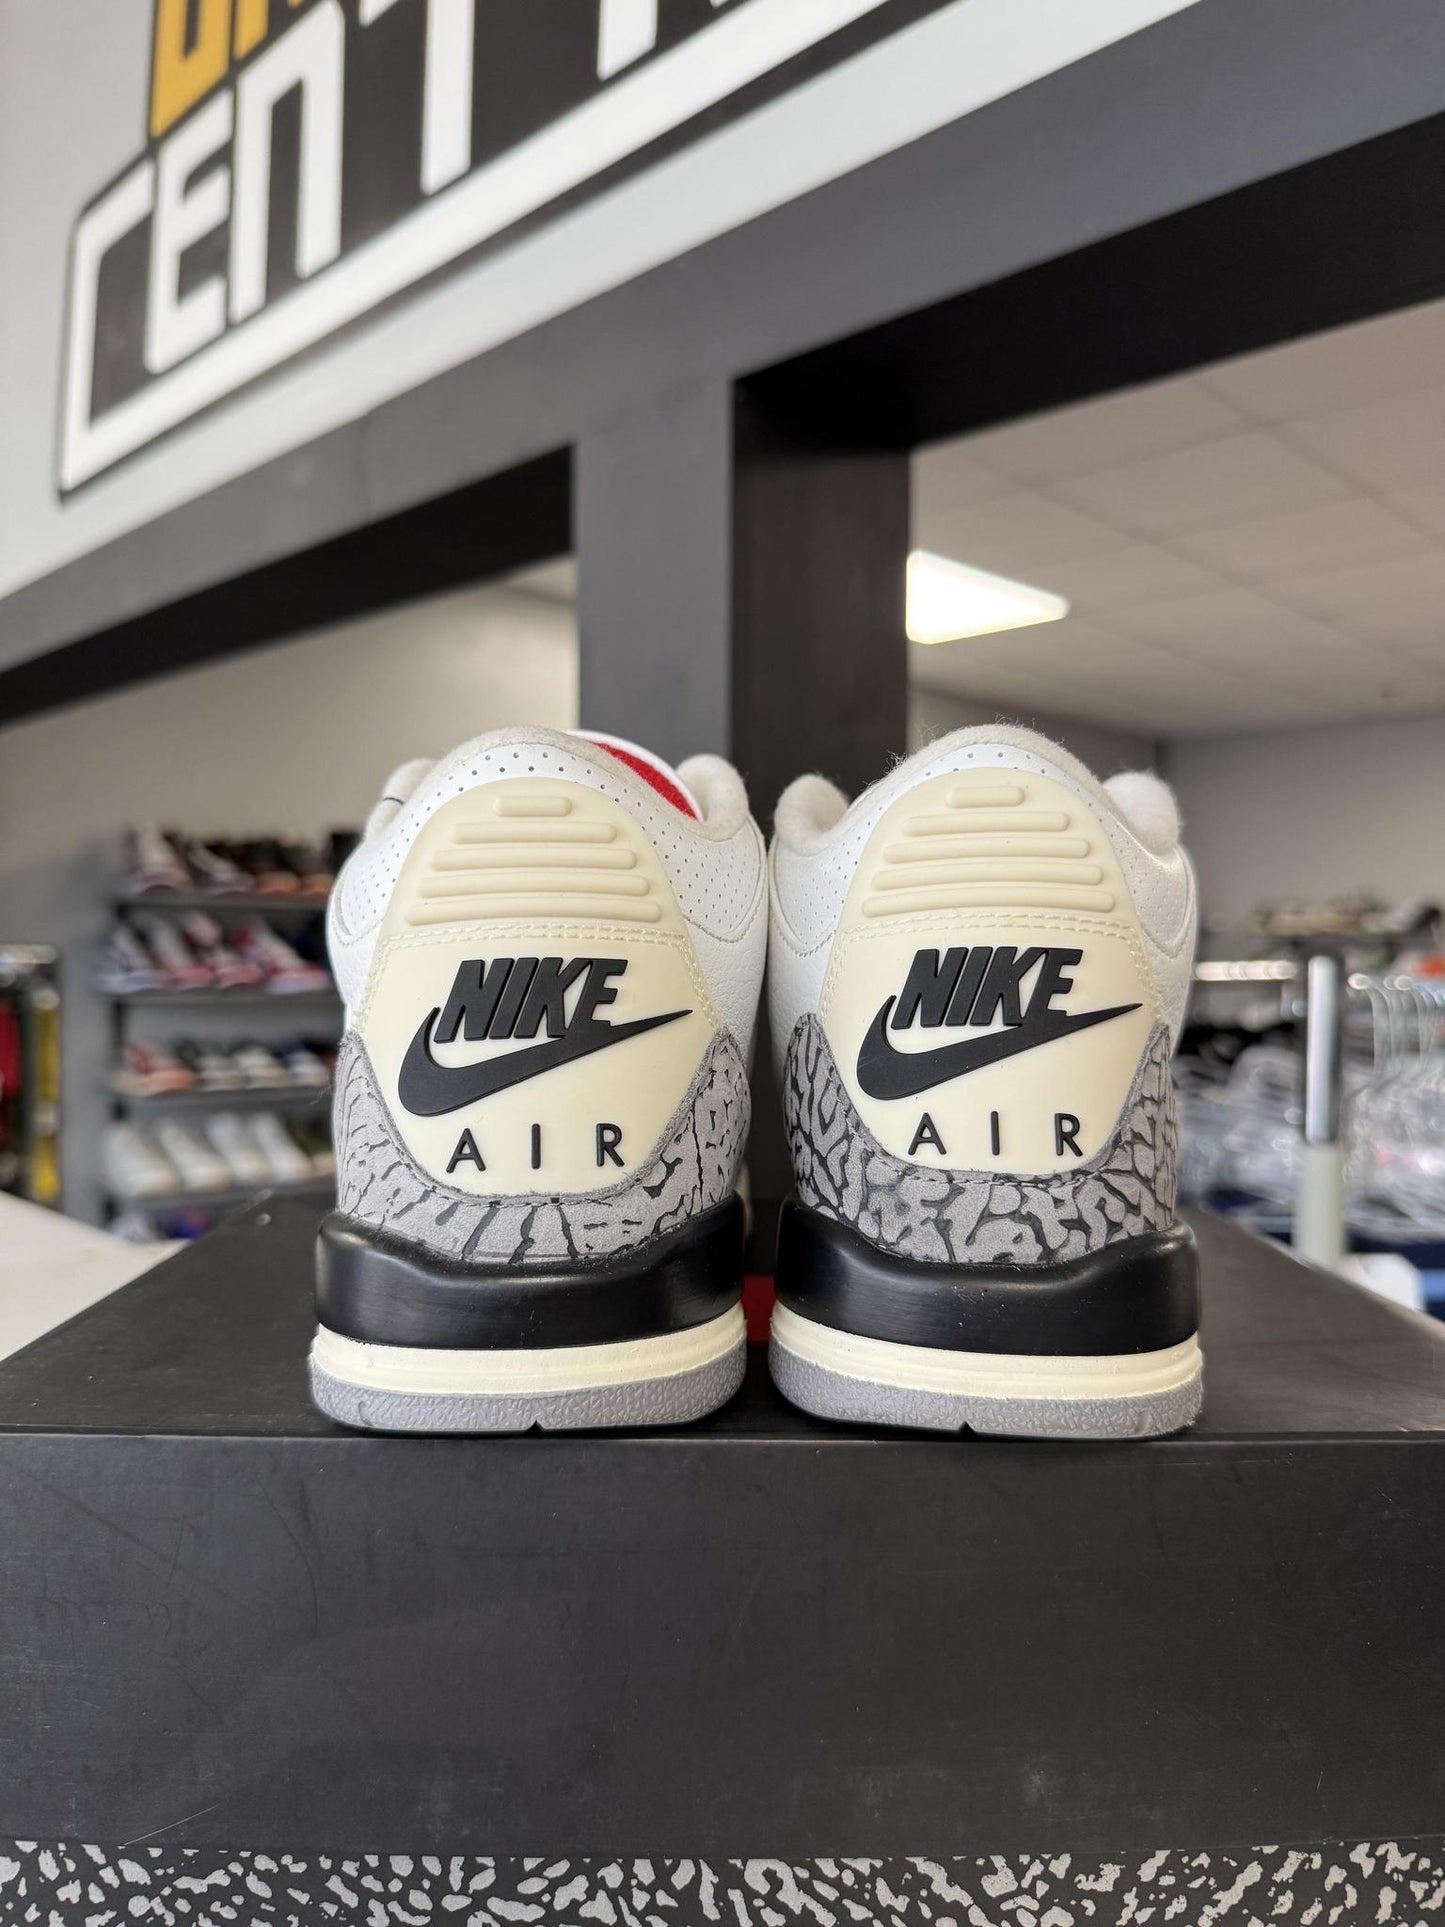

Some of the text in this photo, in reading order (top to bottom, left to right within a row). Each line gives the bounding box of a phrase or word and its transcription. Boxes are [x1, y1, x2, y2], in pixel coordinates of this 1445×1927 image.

[60, 0, 690, 492] CENT
[433, 957, 629, 1044] NIKE
[891, 946, 1084, 1030] NIKE
[445, 1122, 626, 1174] AIR
[907, 1110, 1084, 1157] AIR
